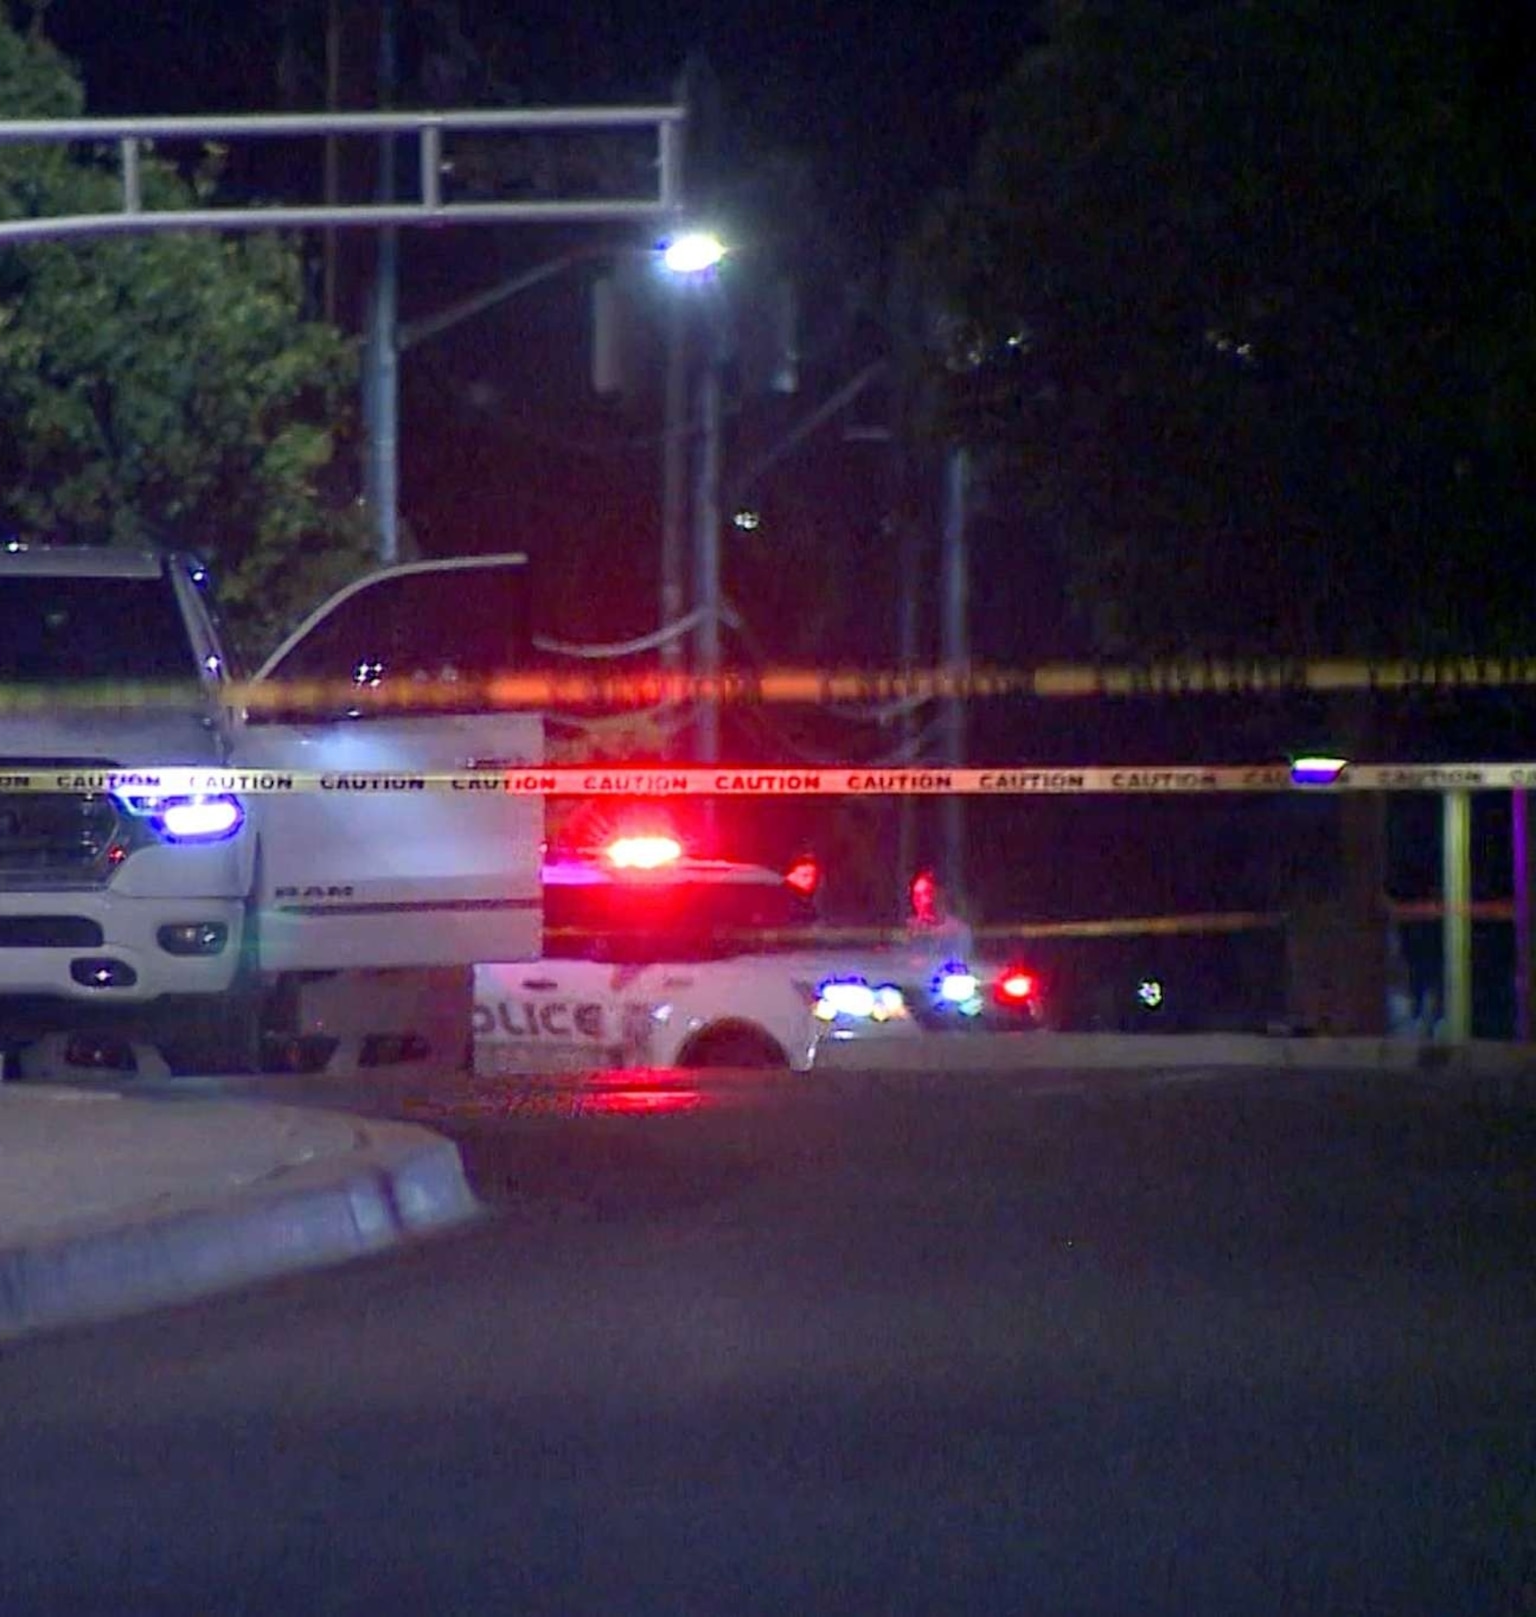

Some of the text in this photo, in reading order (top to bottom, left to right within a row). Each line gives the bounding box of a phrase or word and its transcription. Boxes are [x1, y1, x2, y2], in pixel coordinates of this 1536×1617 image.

[56, 775, 161, 788] CAUTION
[319, 775, 425, 791] CAUTION
[450, 776, 557, 791] CAUTION
[583, 776, 688, 791] CAUTION
[714, 776, 821, 791] CAUTION
[846, 775, 952, 790] CAUTION
[978, 774, 1084, 788] CAUTION
[471, 1002, 602, 1036] OLICE
